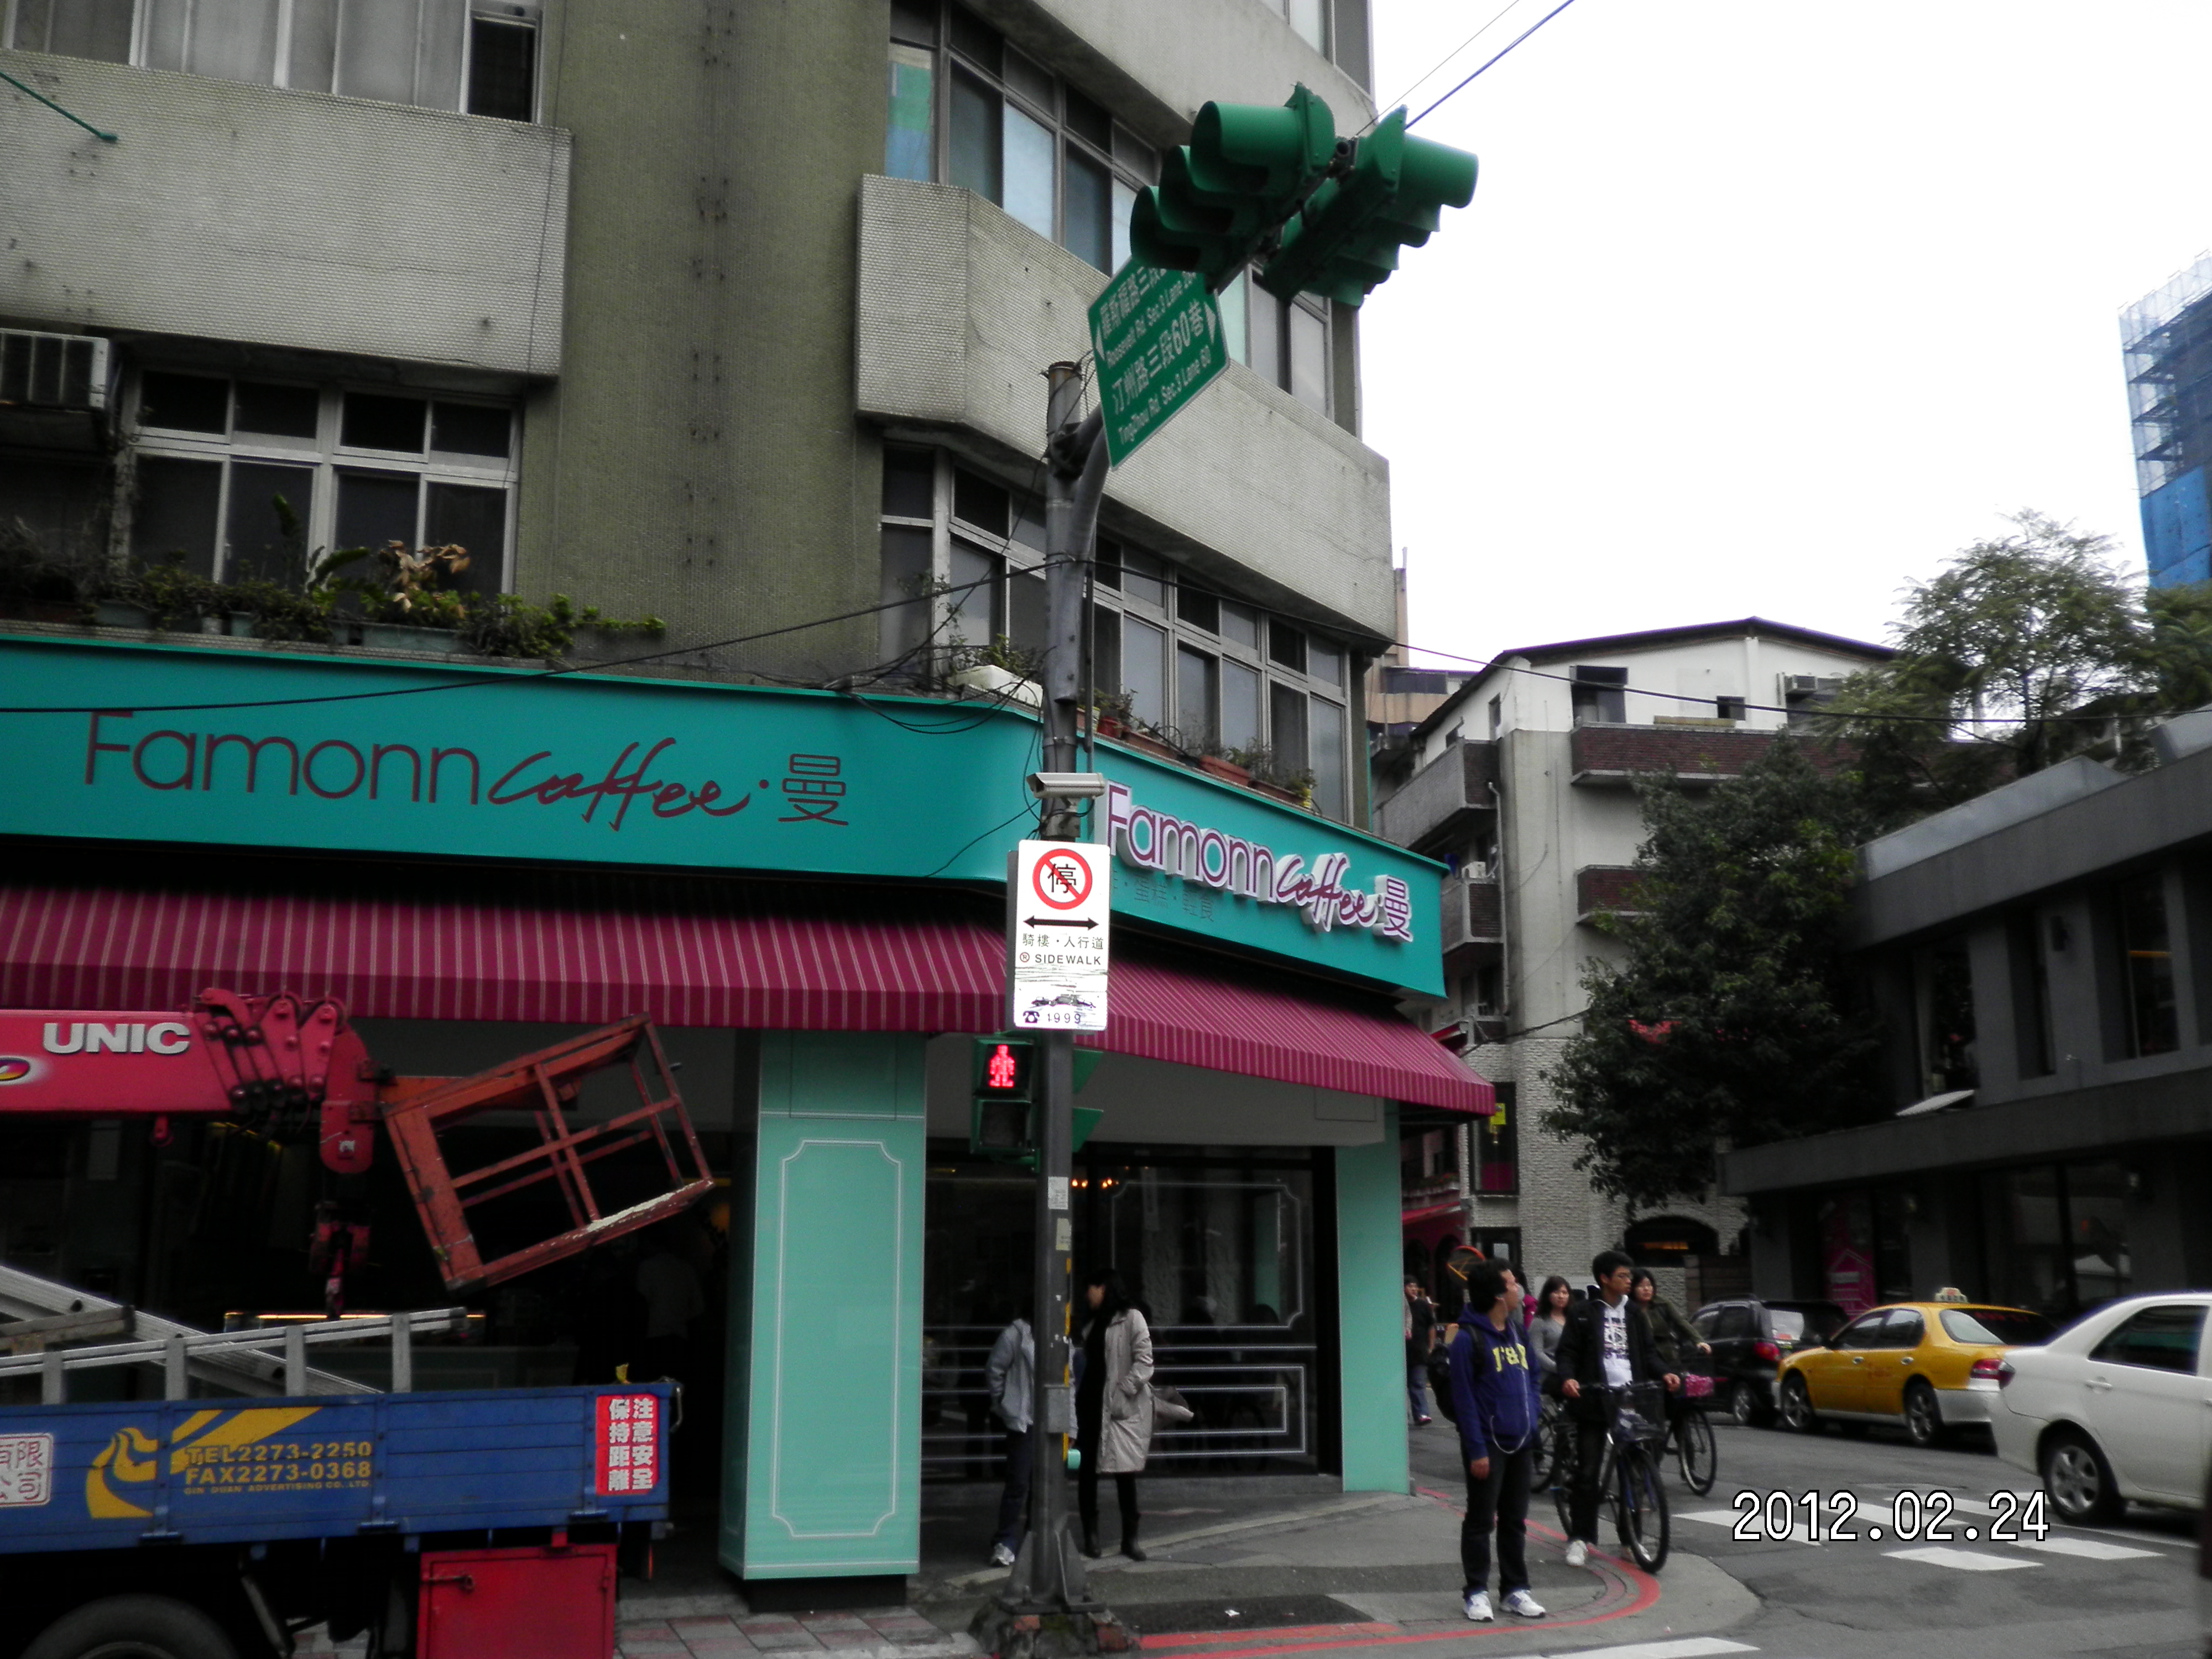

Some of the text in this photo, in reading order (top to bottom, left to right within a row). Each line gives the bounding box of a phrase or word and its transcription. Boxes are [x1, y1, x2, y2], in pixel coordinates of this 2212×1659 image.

[1164, 280, 1183, 307] Lane
[1181, 359, 1200, 386] Lane
[1199, 345, 1211, 368] 60
[85, 711, 479, 805] Famonn
[778, 753, 848, 826] 曼
[1108, 780, 1276, 902] Famonn
[1383, 874, 1413, 942] 曼
[1047, 863, 1077, 894] 停
[1035, 954, 1101, 965] SIDEWALK
[1047, 1012, 1081, 1024] 1999
[43, 1022, 190, 1055] UNIC
[608, 1399, 630, 1491] 保持距離
[632, 1398, 654, 1490] 注意安全
[248, 1482, 322, 1492] ADVERTISING
